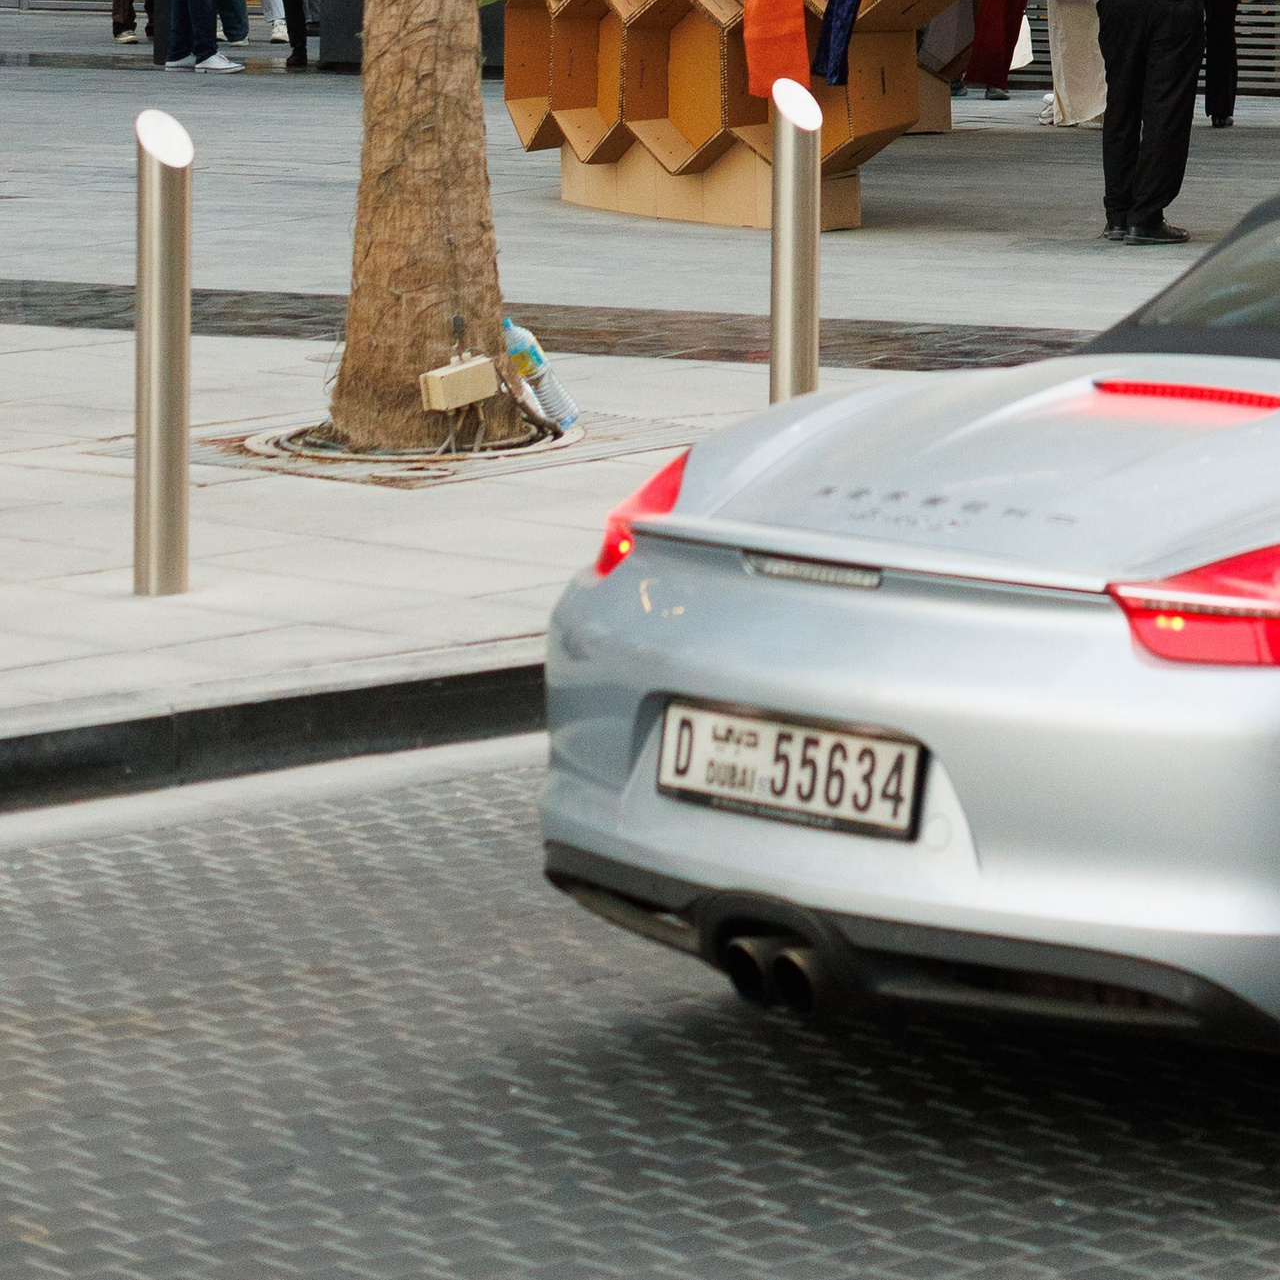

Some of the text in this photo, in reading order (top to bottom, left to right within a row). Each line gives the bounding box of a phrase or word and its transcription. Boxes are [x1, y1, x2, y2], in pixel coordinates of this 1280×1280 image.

[674, 717, 694, 776] D
[770, 731, 905, 820] 55634
[704, 759, 758, 791] DUBAI
